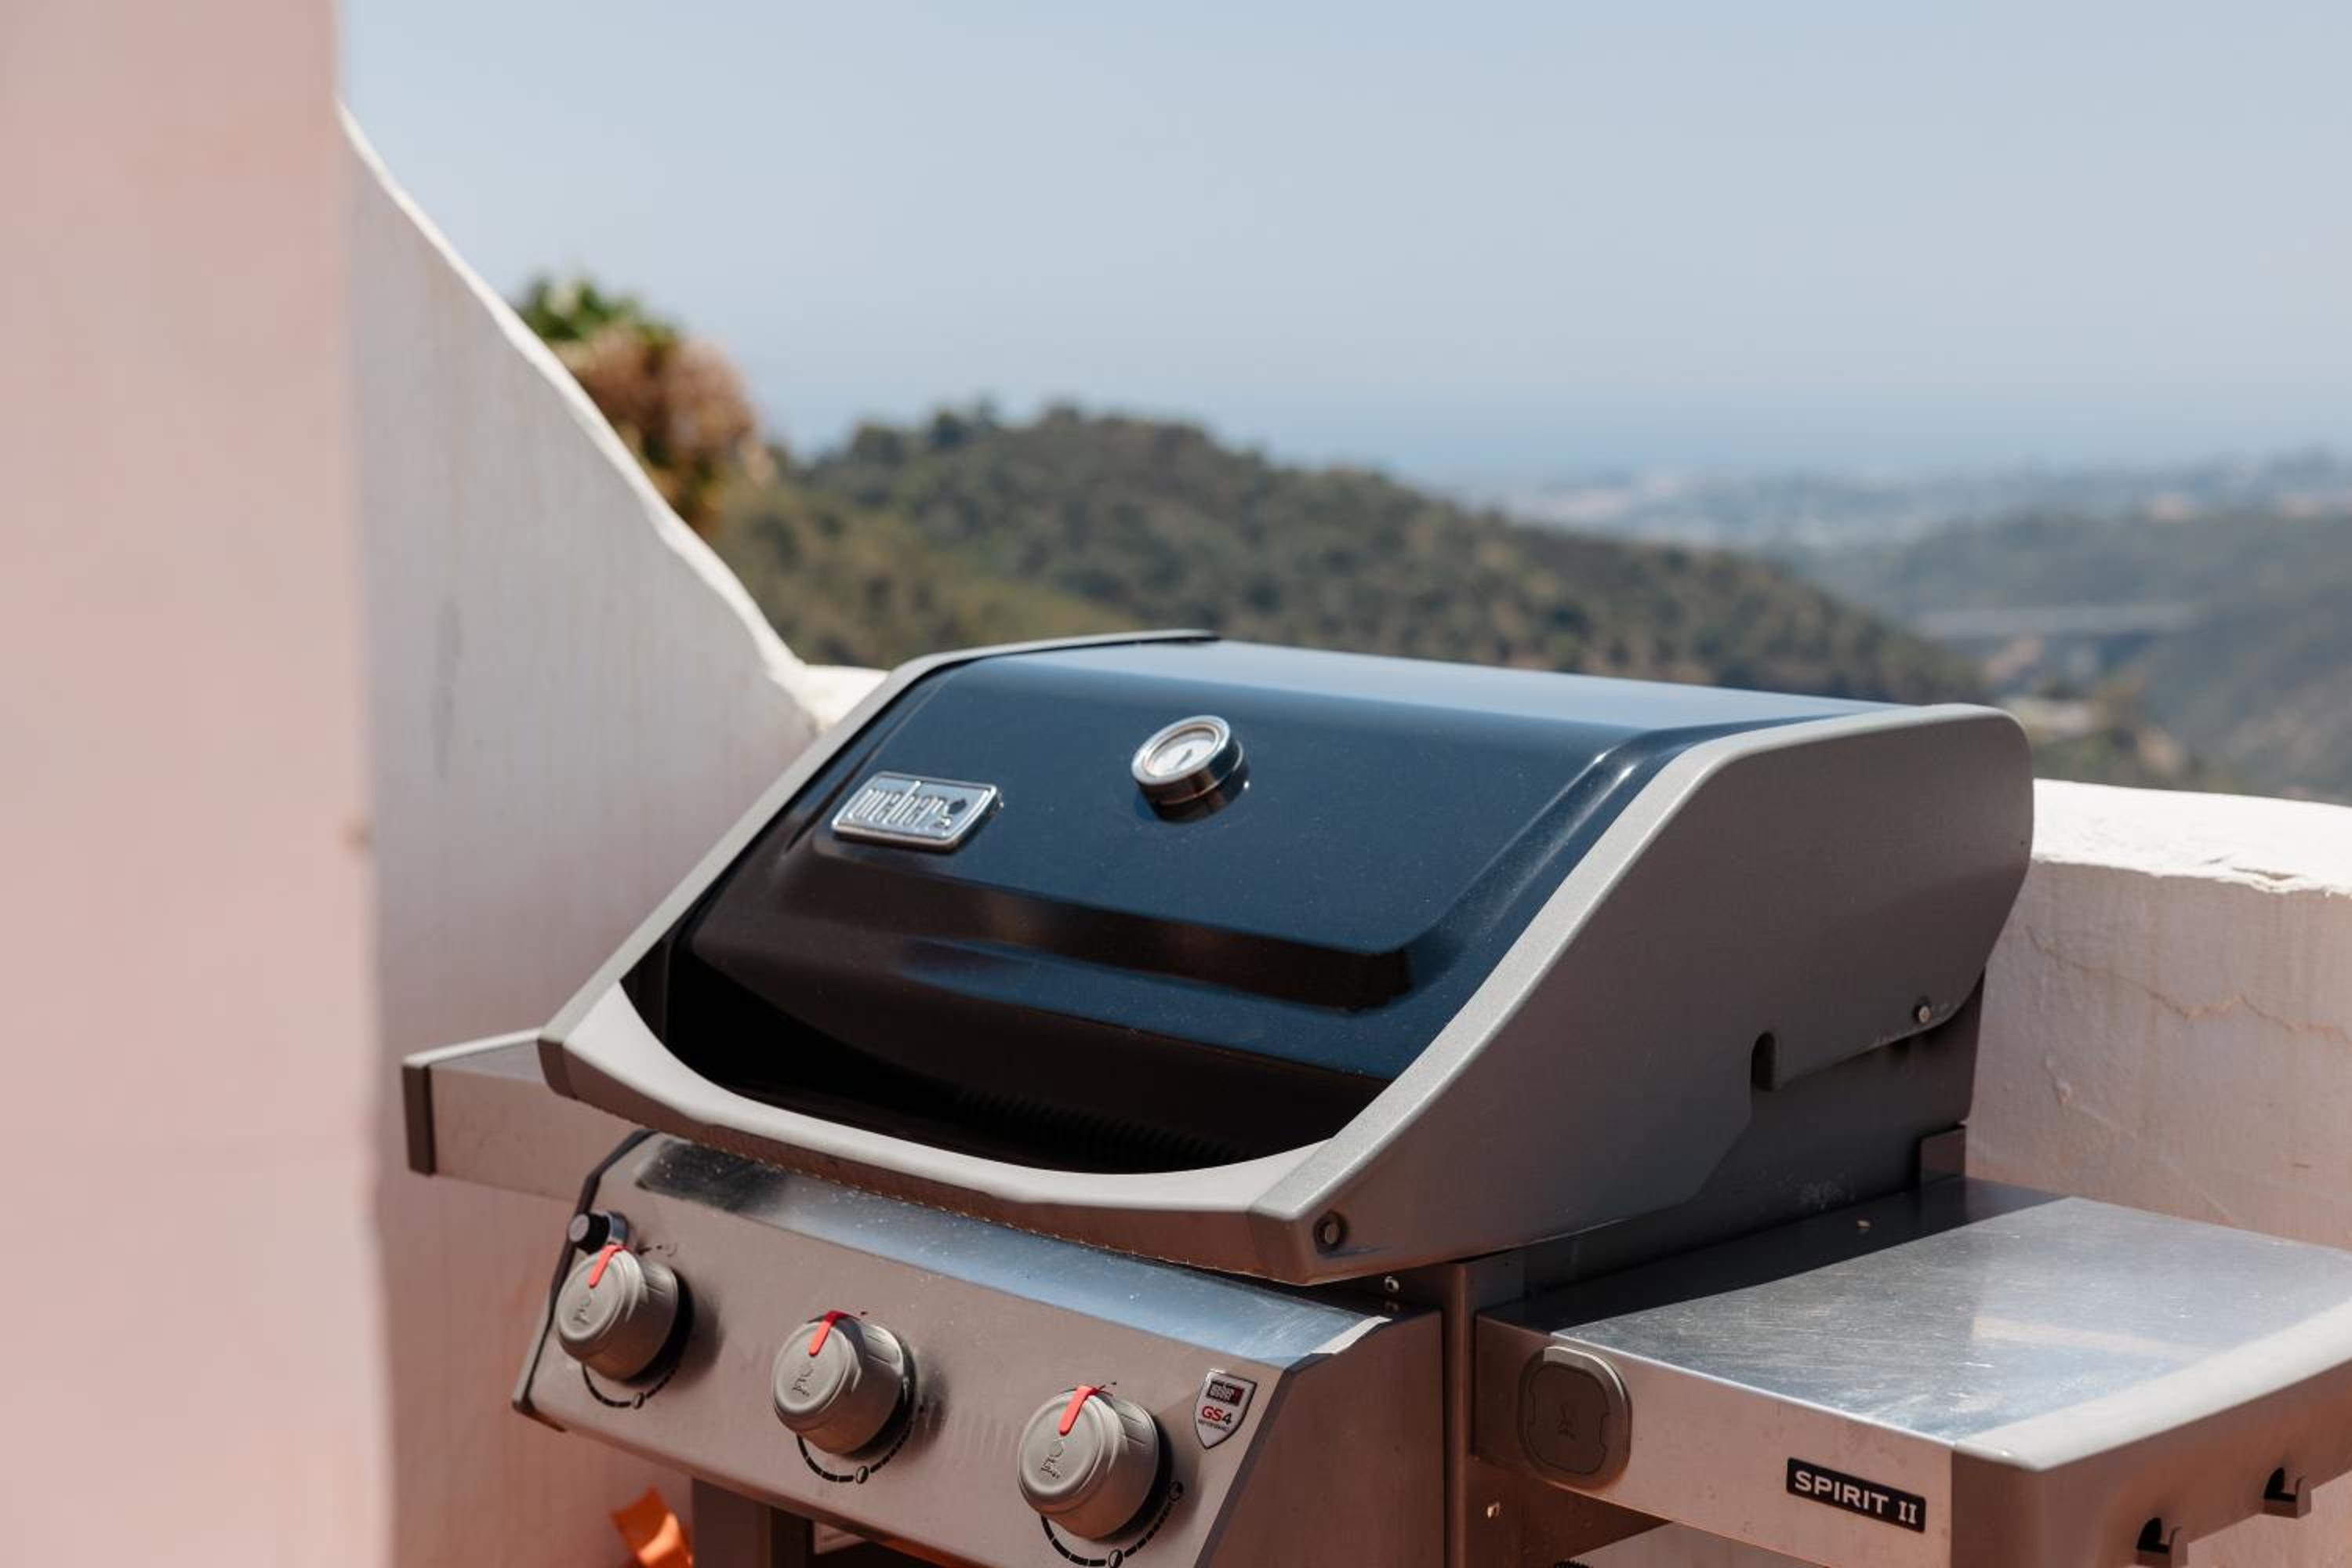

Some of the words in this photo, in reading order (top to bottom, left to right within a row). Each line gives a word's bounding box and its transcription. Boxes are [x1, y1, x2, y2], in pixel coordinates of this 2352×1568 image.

[1202, 1406, 1232, 1425] GS4
[1795, 1470, 1889, 1515] SPIRIT
[1898, 1501, 1918, 1525] II
